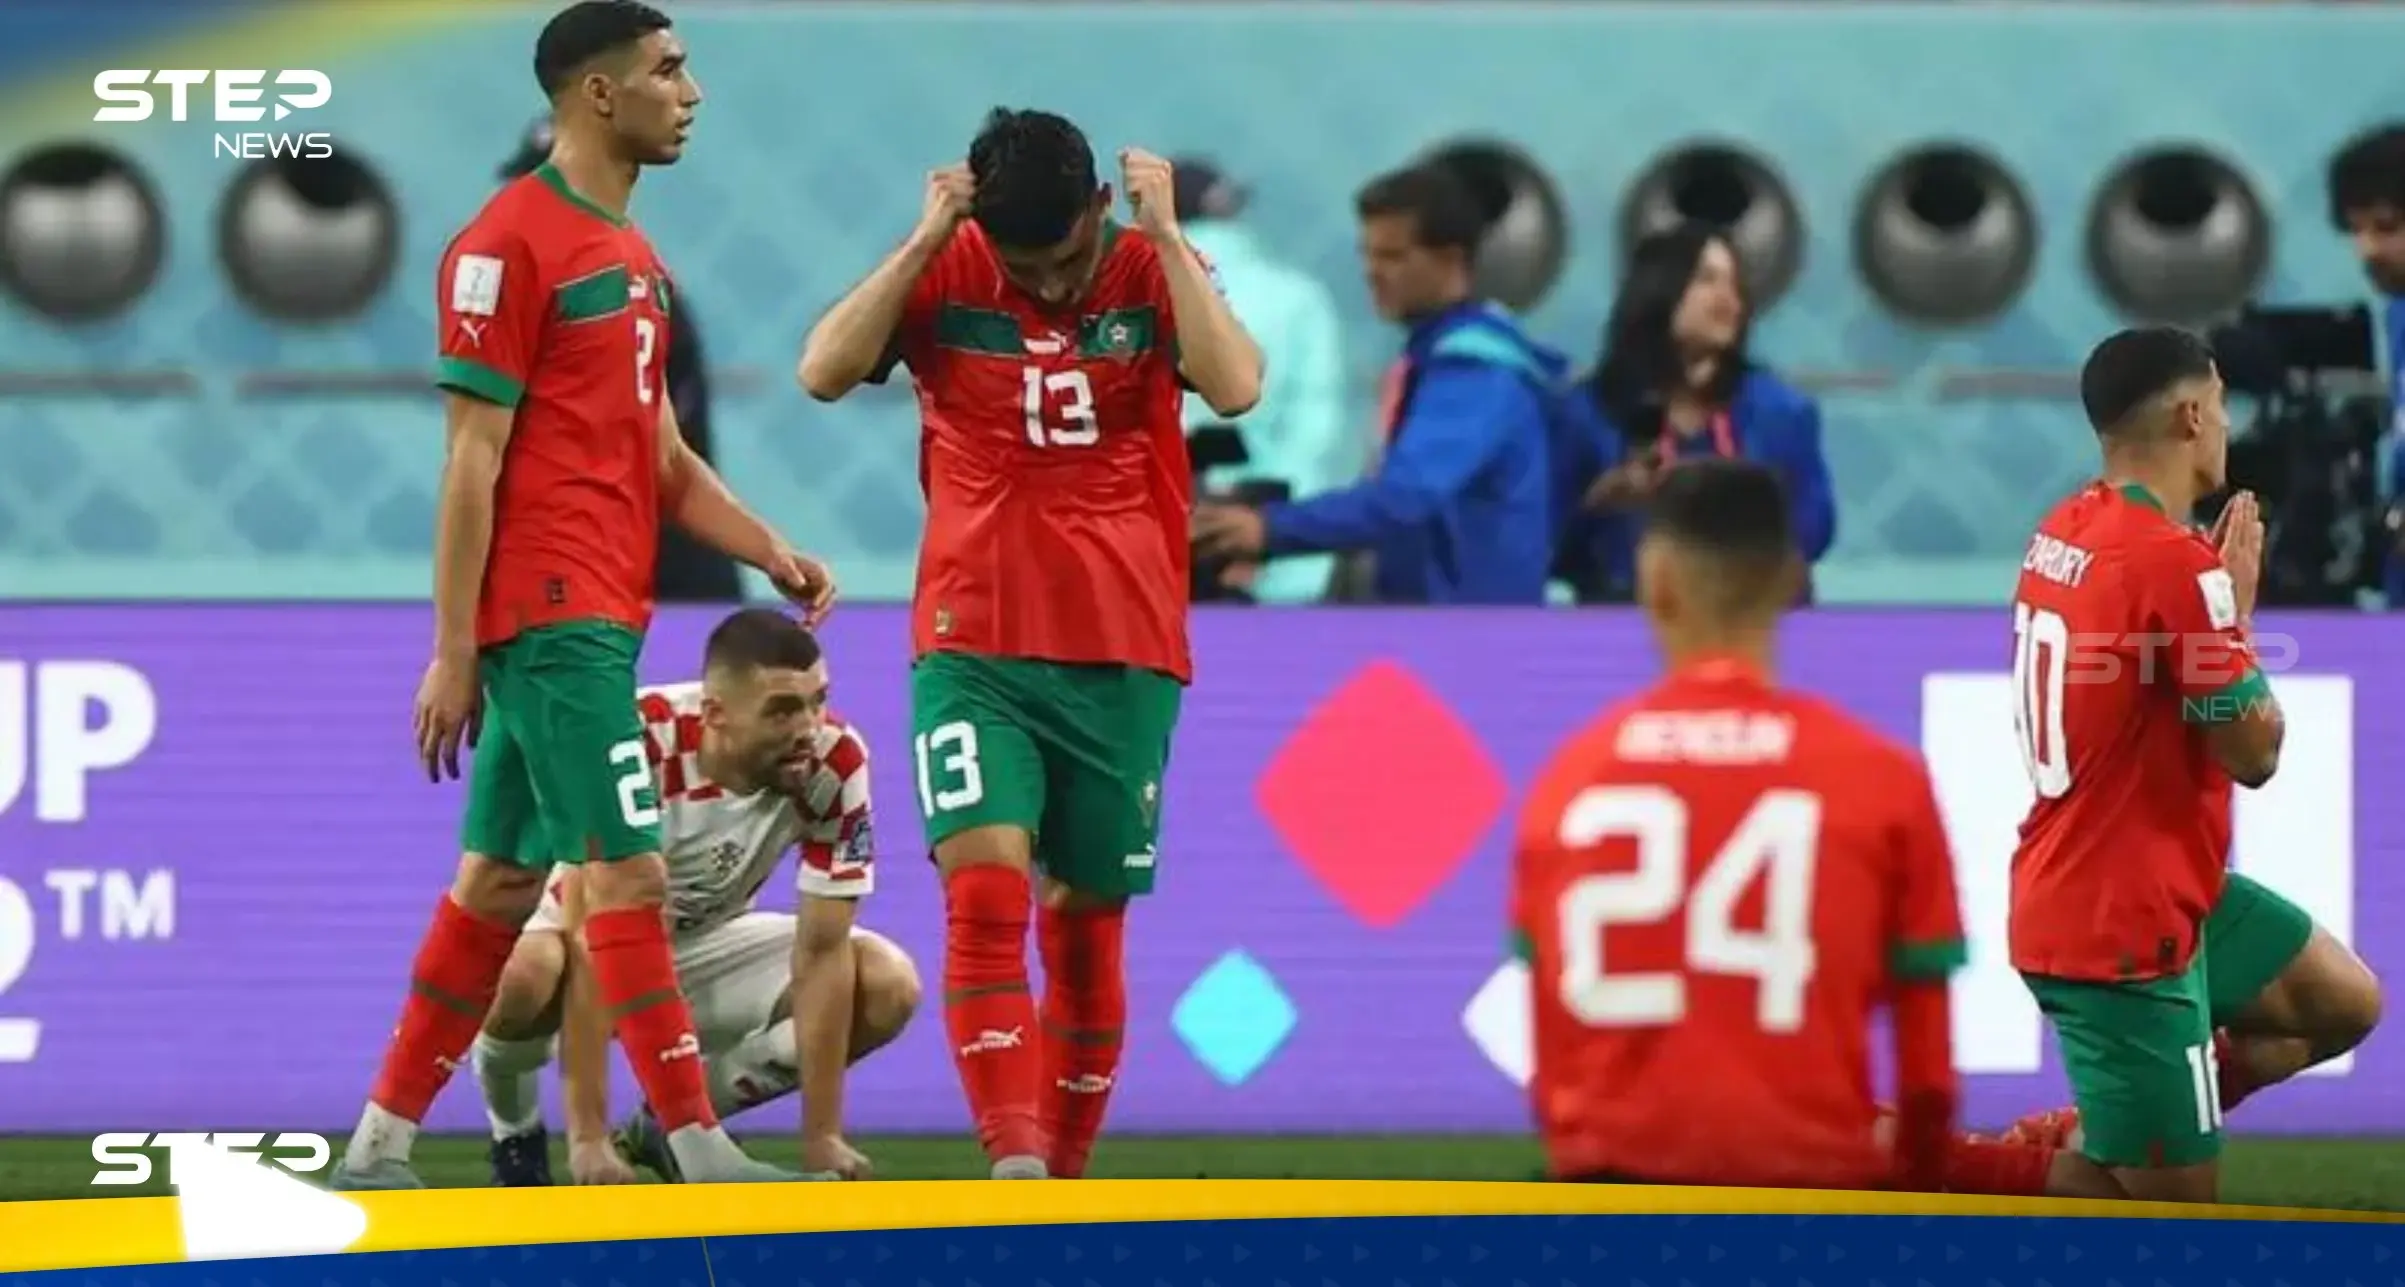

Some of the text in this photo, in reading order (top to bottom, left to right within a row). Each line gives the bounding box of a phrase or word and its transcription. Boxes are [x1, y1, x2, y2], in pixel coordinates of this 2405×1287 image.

[1023, 365, 1100, 447] 13
[0, 660, 157, 822] P
[609, 739, 660, 828] 2
[914, 720, 983, 818] 13
[1557, 782, 1824, 1034] 24
